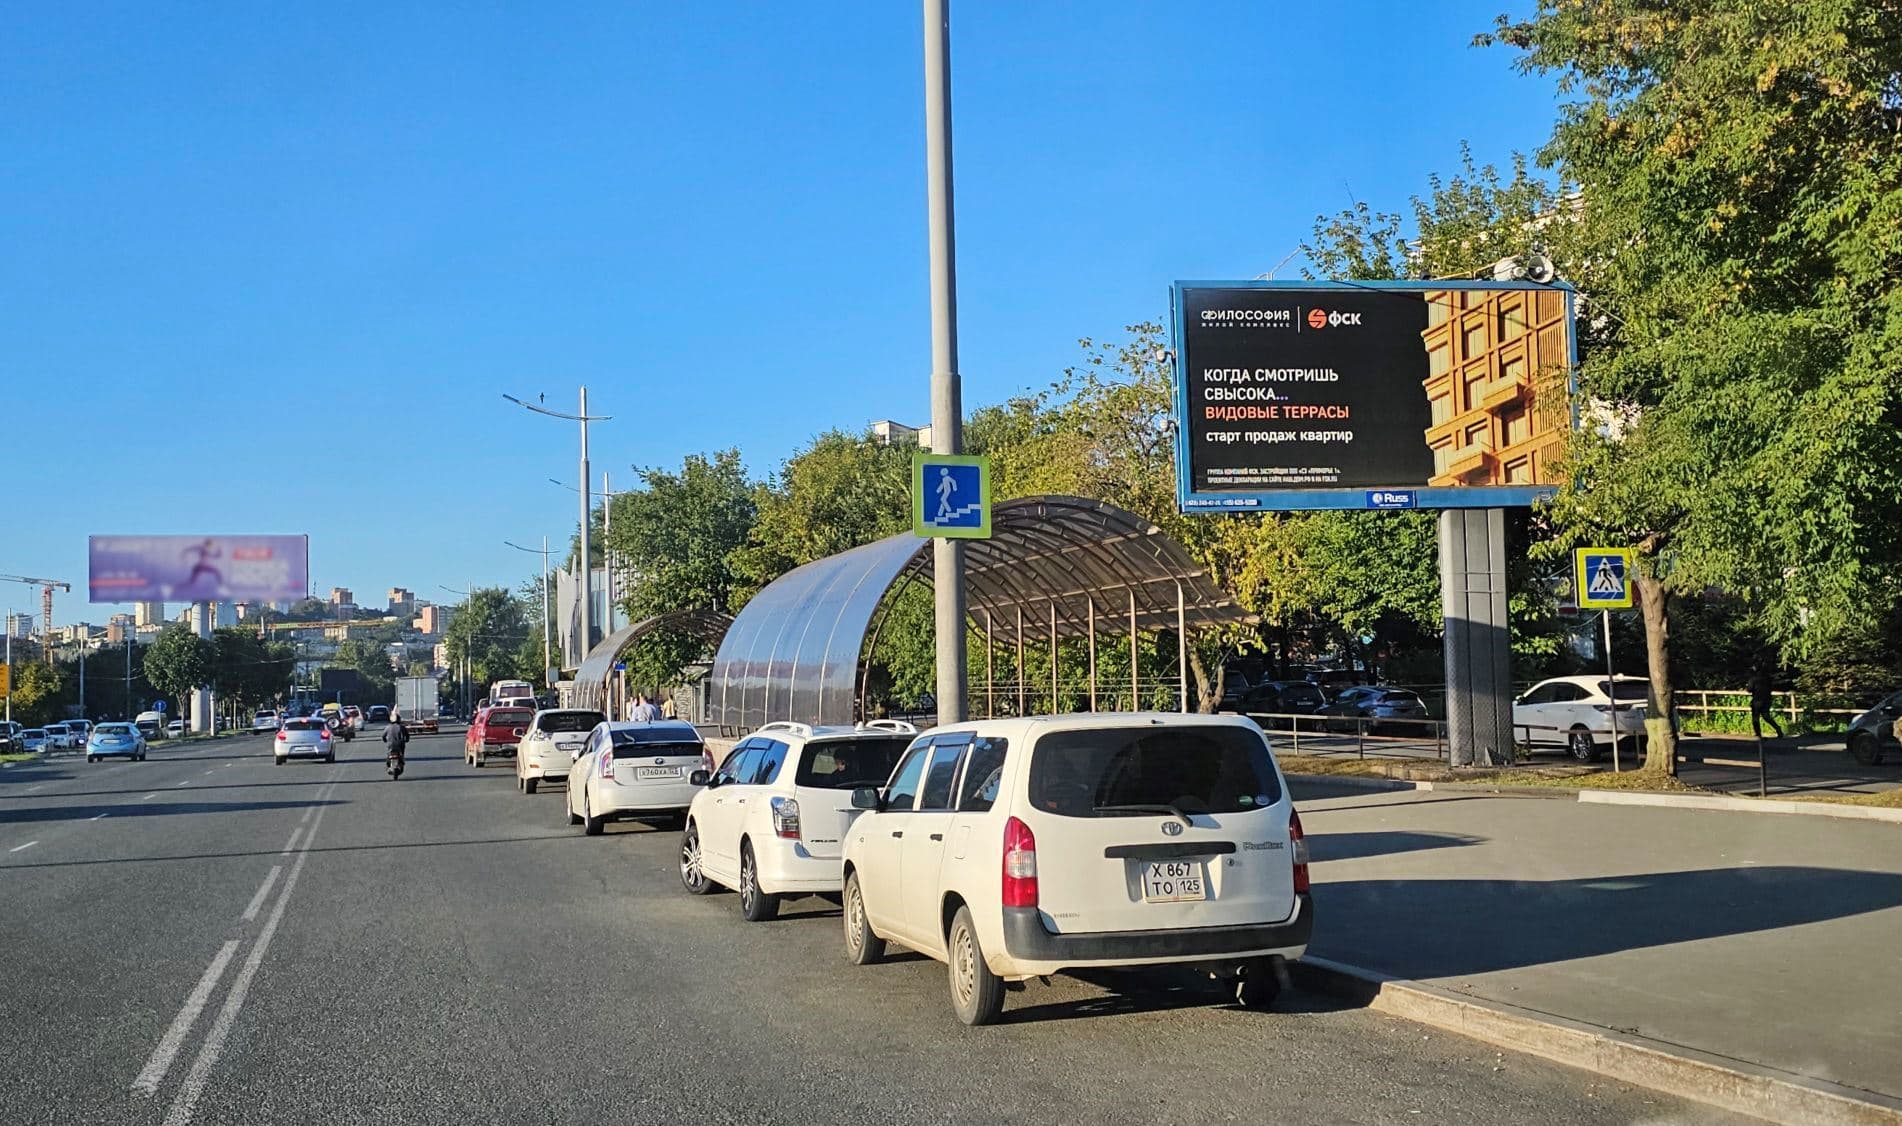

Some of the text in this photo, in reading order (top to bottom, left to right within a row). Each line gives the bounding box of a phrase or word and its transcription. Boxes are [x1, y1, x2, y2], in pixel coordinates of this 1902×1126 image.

[1204, 368, 1339, 384] КОГДА СМОТРИШЬ
[1204, 387, 1289, 401] СВЫСОКА...
[1205, 405, 1350, 421] ВИДОВЫЕ ТЕРРАСЫ
[1206, 430, 1353, 444] старт продаж квартир
[1384, 493, 1409, 503] Russ
[1167, 862, 1191, 877] 867
[1180, 880, 1200, 892] 125
